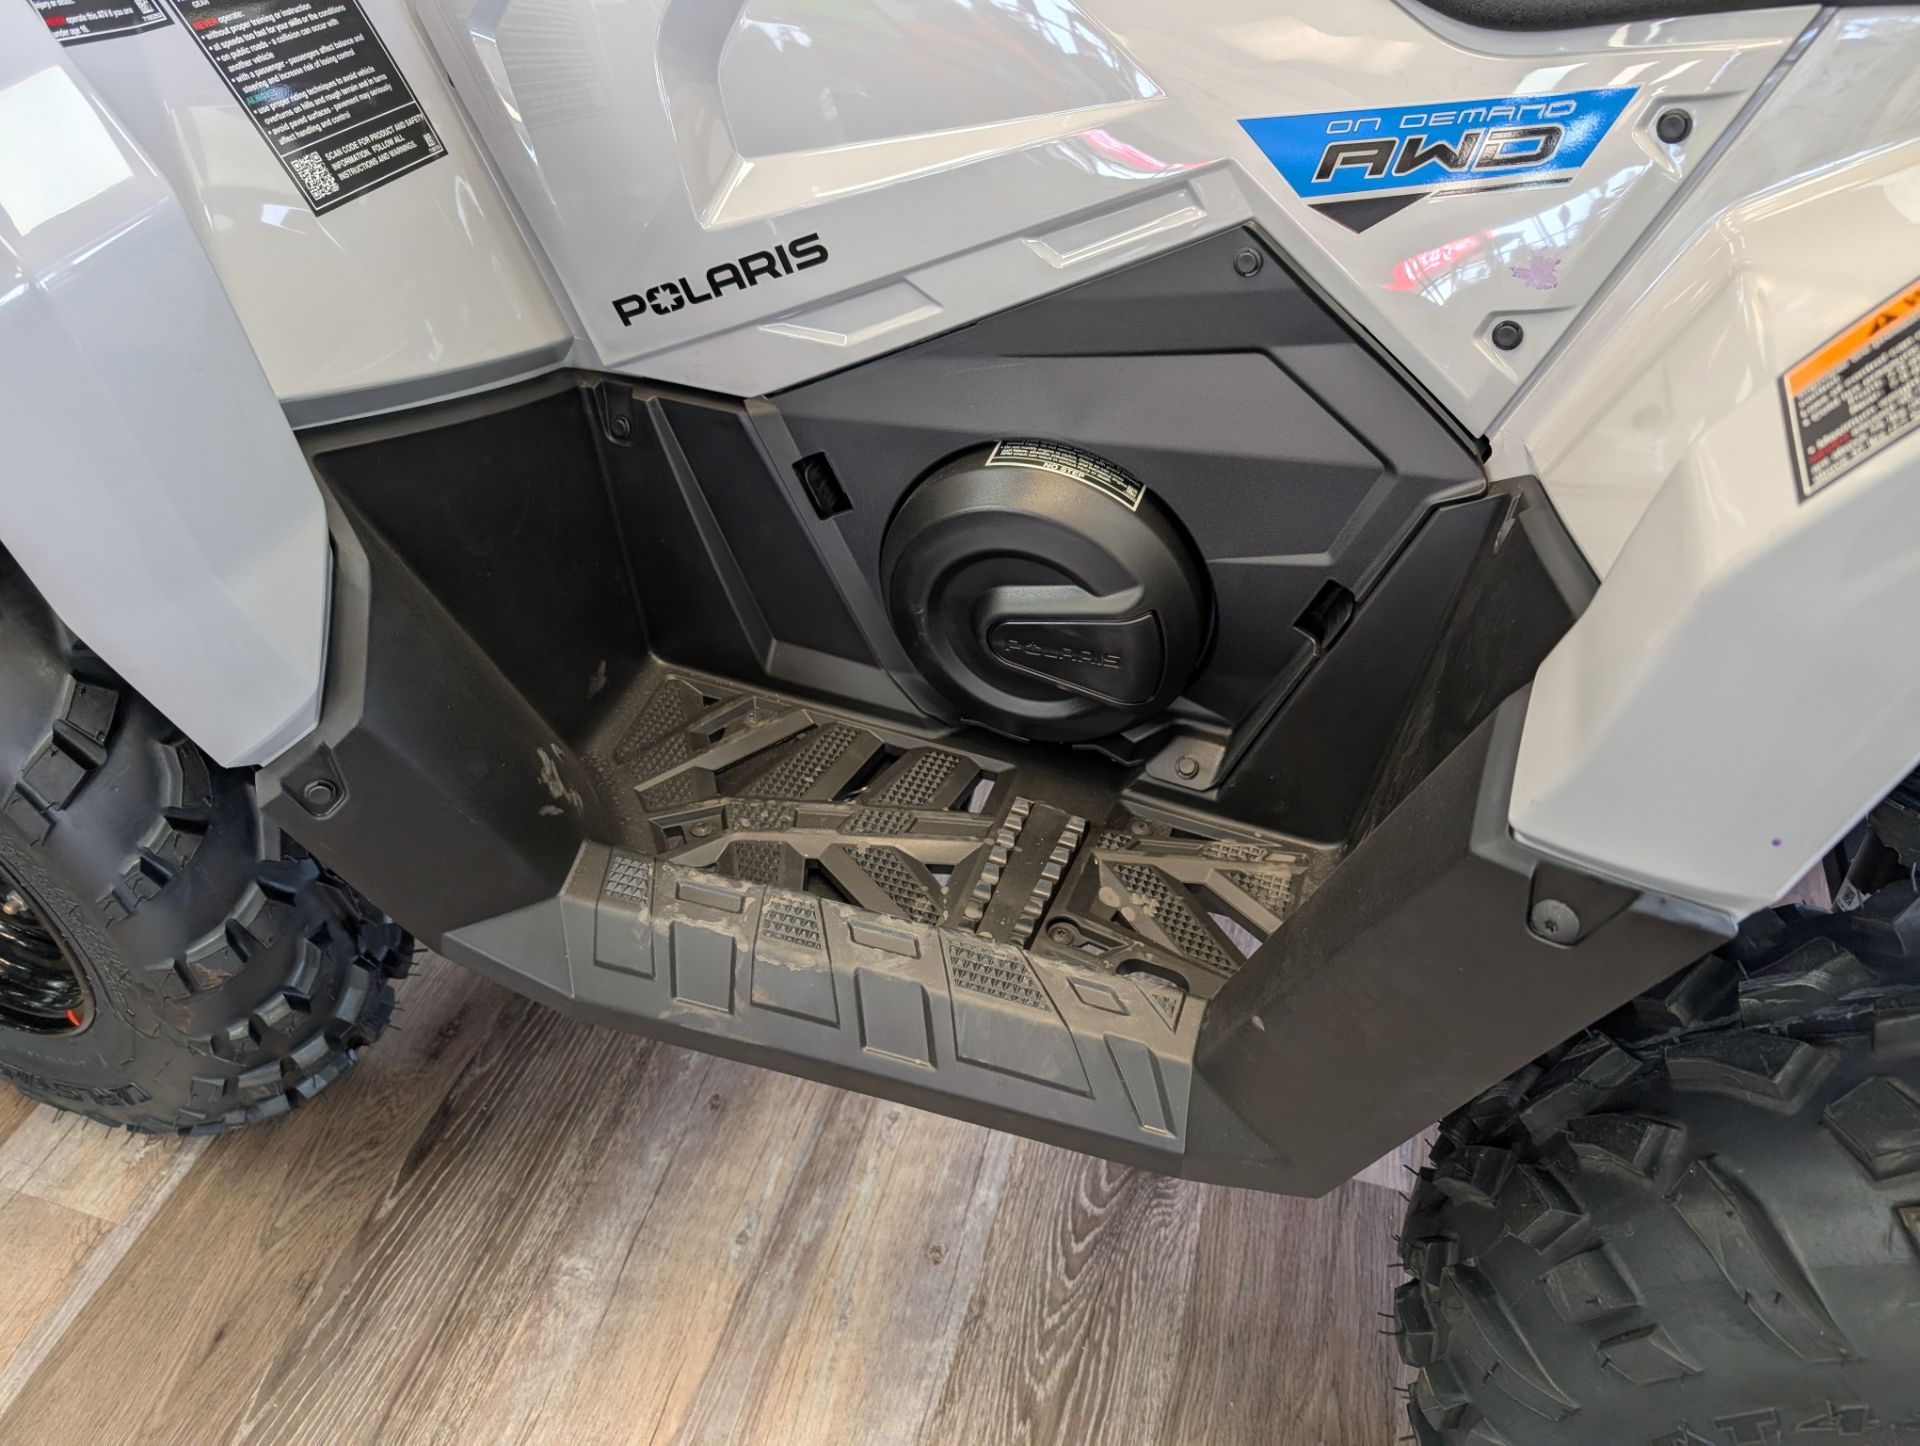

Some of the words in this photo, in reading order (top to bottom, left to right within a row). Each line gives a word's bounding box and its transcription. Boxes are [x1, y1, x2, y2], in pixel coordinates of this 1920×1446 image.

[1327, 117, 1381, 134] ON
[1401, 101, 1577, 128] DEMAND
[325, 148, 343, 161] SCAN
[342, 141, 359, 154] CODE
[357, 136, 371, 147] FOR
[369, 125, 395, 141] PRODUCT
[394, 121, 406, 131] AND
[371, 138, 394, 153] FOLLOW
[394, 134, 405, 143] ALL
[1312, 125, 1565, 183] AWD
[338, 157, 379, 181] INSTRUCTIONS
[378, 152, 390, 163] AND
[612, 232, 829, 327] POLARIS
[1043, 462, 1059, 470] NO
[1060, 466, 1085, 478] STEP
